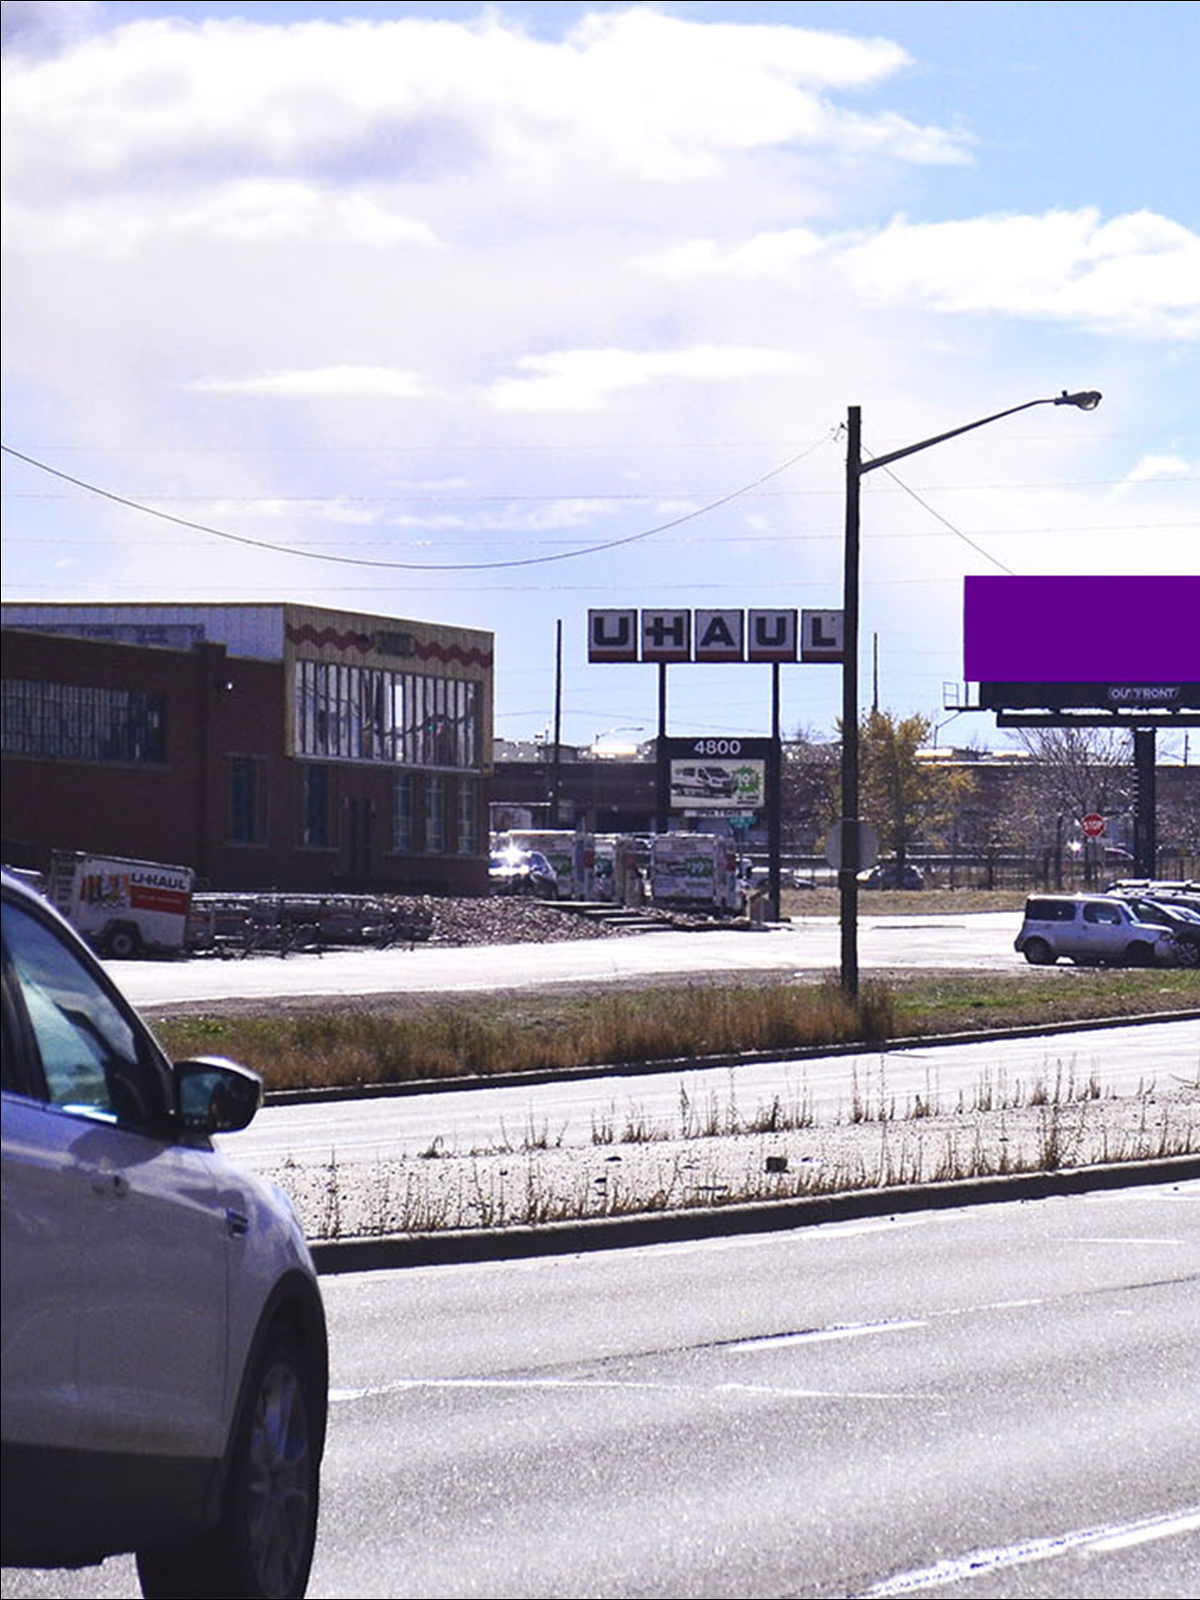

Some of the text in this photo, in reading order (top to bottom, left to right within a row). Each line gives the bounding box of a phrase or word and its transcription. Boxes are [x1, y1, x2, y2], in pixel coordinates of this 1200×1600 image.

[694, 740, 741, 755] 4800
[1083, 820, 1103, 830] STOP
[131, 872, 187, 890] U-HAUL
